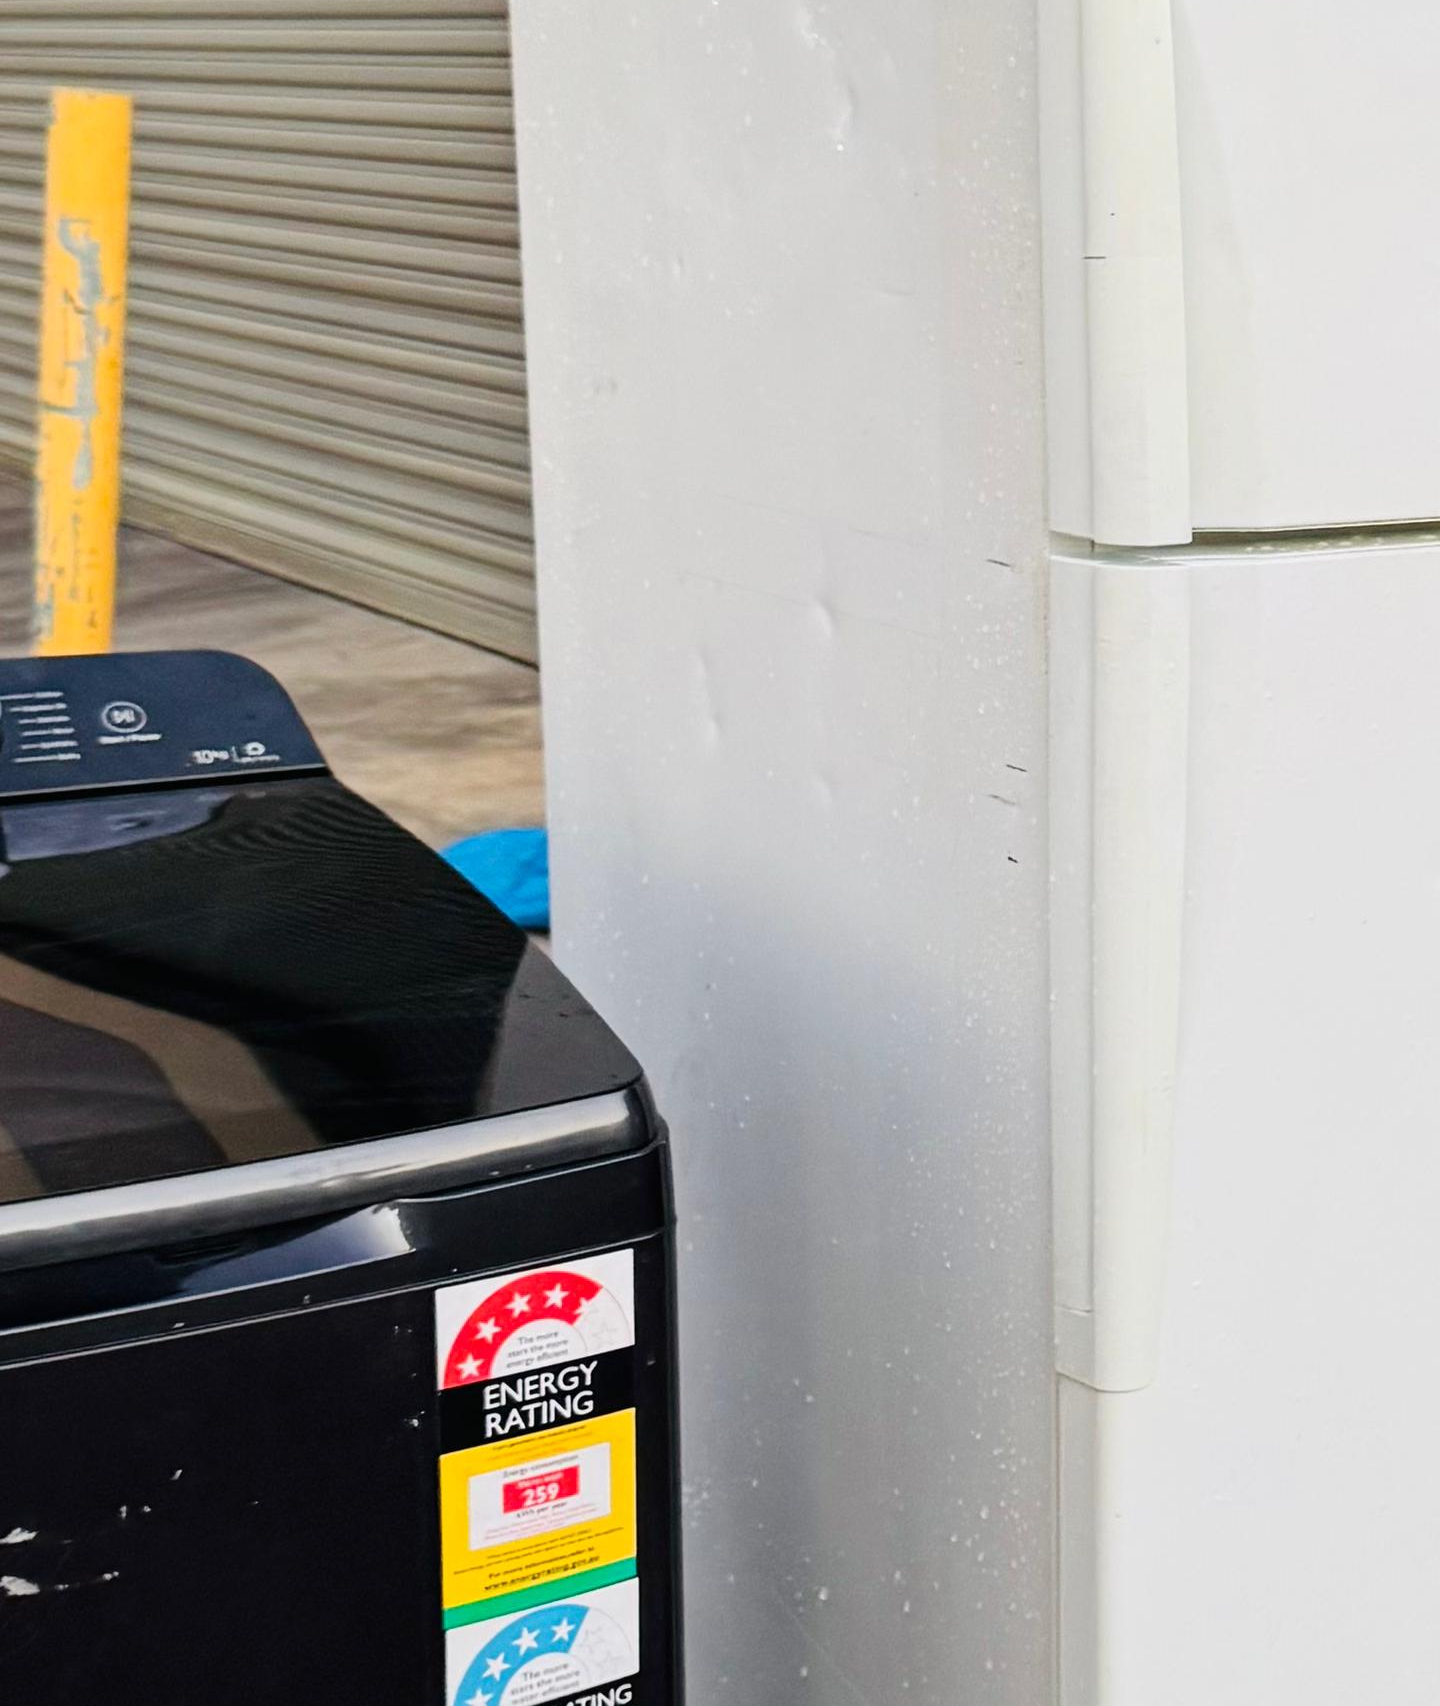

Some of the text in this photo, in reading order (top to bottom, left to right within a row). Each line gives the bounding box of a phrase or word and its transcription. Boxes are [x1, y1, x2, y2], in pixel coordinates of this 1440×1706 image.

[482, 1360, 598, 1410] ENERGY
[484, 1390, 595, 1438] RATING
[521, 1482, 560, 1506] 259
